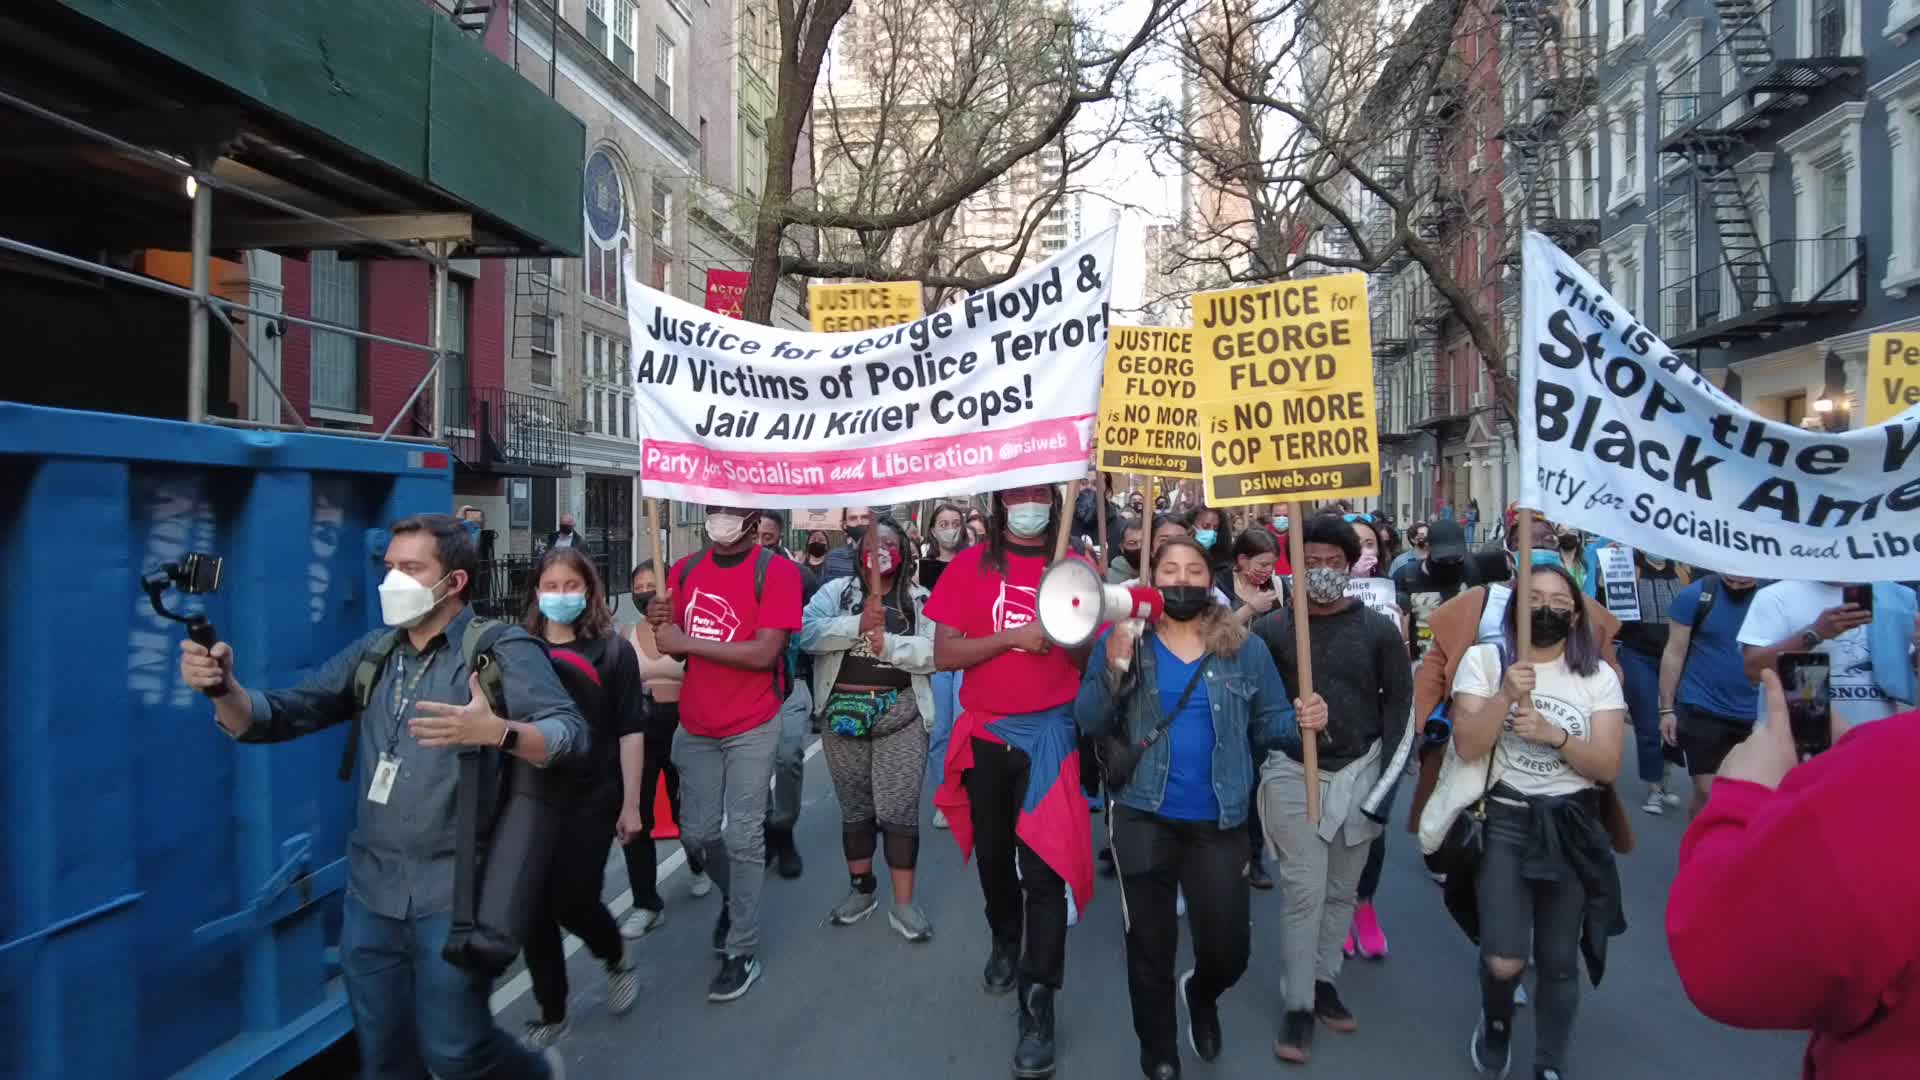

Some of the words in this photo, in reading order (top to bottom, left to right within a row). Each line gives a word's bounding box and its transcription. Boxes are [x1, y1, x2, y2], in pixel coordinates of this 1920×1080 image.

[647, 306, 761, 355] Justice
[770, 341, 823, 360] for
[964, 267, 1063, 329] Floyd
[1076, 253, 1102, 292] &
[710, 283, 747, 298] ACTO
[817, 287, 891, 310] JUSTICE
[1203, 285, 1320, 328] JUSTICE
[1330, 292, 1357, 313] for
[1555, 269, 1615, 330] This
[1620, 320, 1656, 356] is
[638, 350, 679, 385] All
[687, 357, 809, 401] Victims
[820, 365, 853, 399] of
[865, 351, 978, 396] Police
[991, 302, 1109, 365] Terror!
[1114, 330, 1193, 353] JUSTICE
[1212, 318, 1351, 361] GEORGE
[1126, 377, 1196, 399] FLOYD
[1230, 353, 1337, 391] FLOYD
[1538, 309, 1686, 422] Stop
[1709, 414, 1849, 475] the
[695, 404, 760, 438] Jail
[764, 412, 816, 440] All
[824, 402, 919, 438] Killer
[930, 374, 1033, 426] Cops!
[1108, 409, 1120, 422] is
[1124, 404, 1151, 424] NO
[1210, 416, 1229, 435] is
[1234, 401, 1273, 431] NO
[1283, 391, 1365, 425] MORE
[1105, 426, 1139, 446] COP
[1145, 429, 1200, 451] TERRO
[1210, 437, 1262, 468] COP
[1270, 426, 1369, 462] TERROR
[1535, 379, 1726, 501] Black
[647, 448, 699, 480] Party
[702, 456, 722, 481] for
[722, 459, 825, 485] Socialism
[830, 456, 867, 481] and
[871, 443, 993, 479] Liberation
[1120, 455, 1188, 471] pslweb.org
[1239, 468, 1343, 496] pslweb.org
[1584, 482, 1624, 510] for
[1630, 492, 1782, 557] Socialism
[1789, 539, 1840, 559] and
